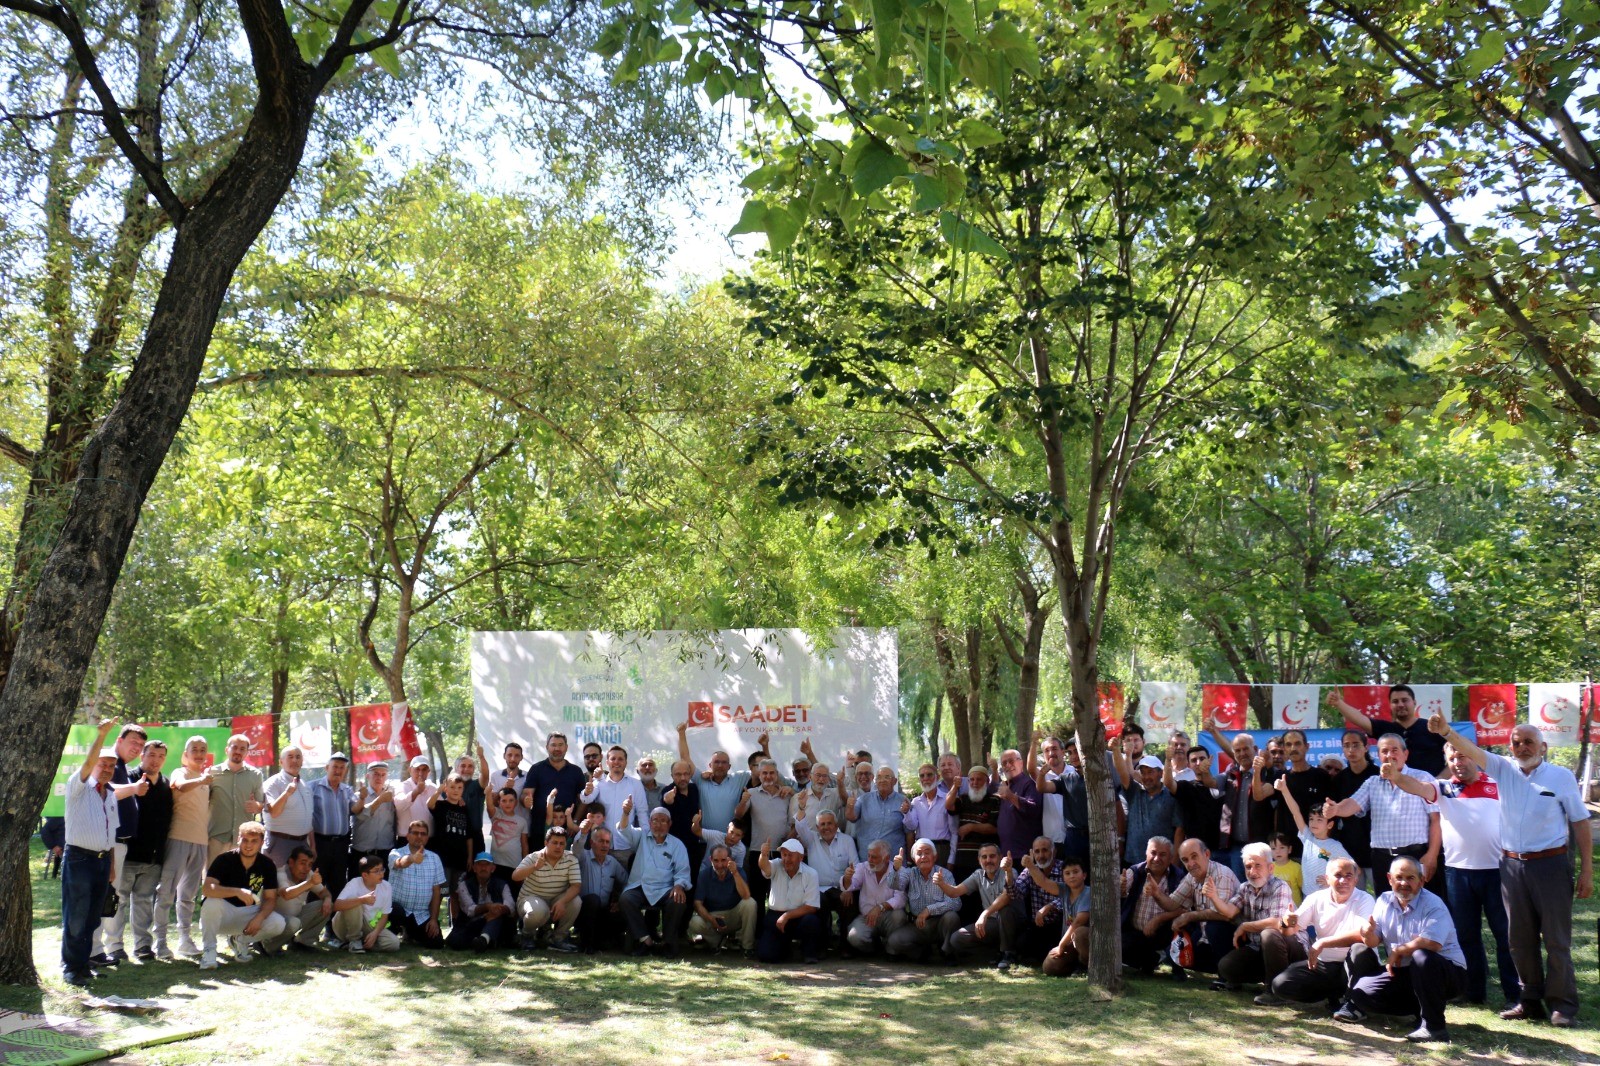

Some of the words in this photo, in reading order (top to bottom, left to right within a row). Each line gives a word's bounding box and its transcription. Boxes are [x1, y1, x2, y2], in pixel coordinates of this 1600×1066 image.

[718, 704, 812, 723] SAADET
[1146, 721, 1178, 730] SAADET
[1538, 725, 1573, 733] SAADET
[1476, 729, 1509, 738] SAADET
[357, 744, 386, 753] SAADET
